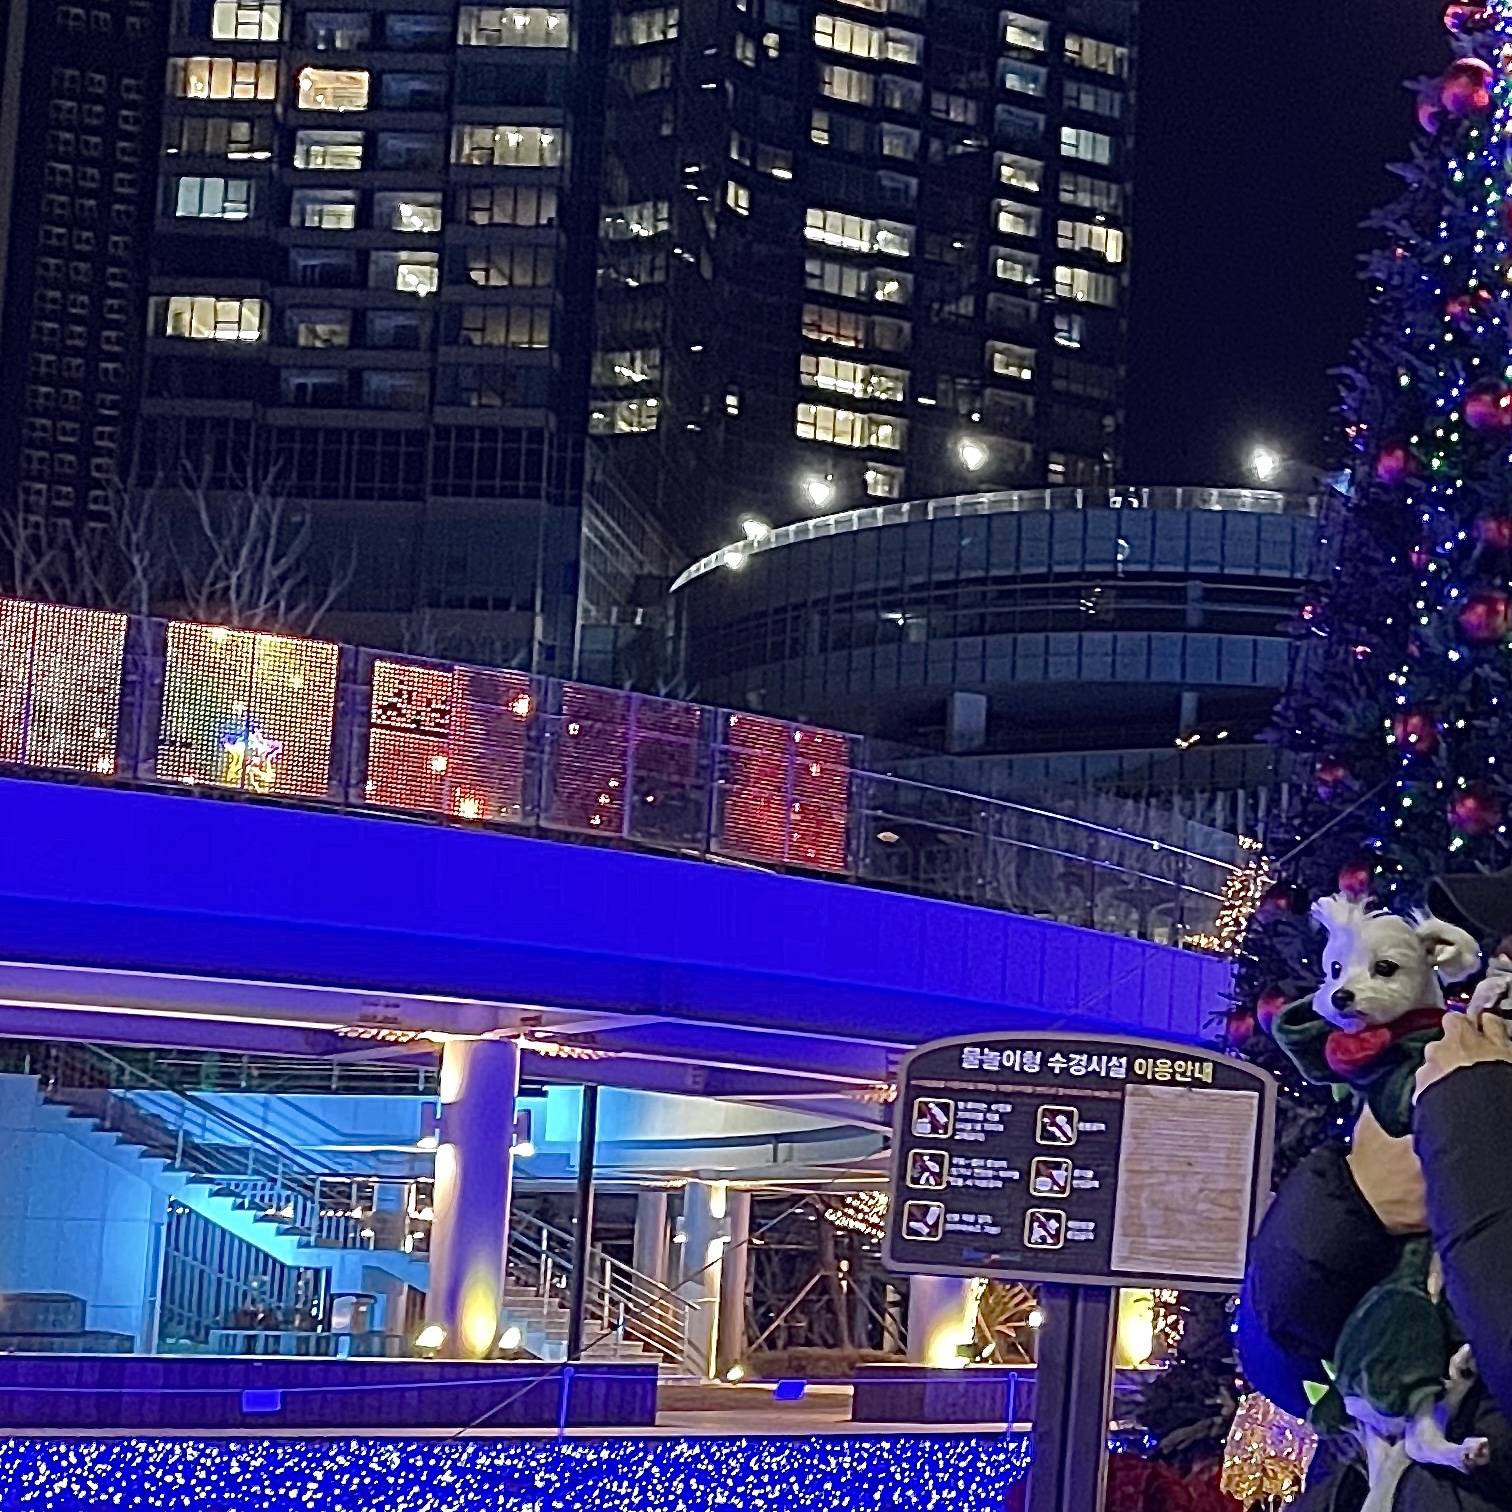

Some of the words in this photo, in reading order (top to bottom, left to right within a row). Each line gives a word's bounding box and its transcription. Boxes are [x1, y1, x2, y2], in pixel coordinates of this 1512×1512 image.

[962, 1047, 1041, 1072] 물놀이형
[1047, 1052, 1127, 1078] 수경시설
[1133, 1058, 1213, 1083] 이용안내
